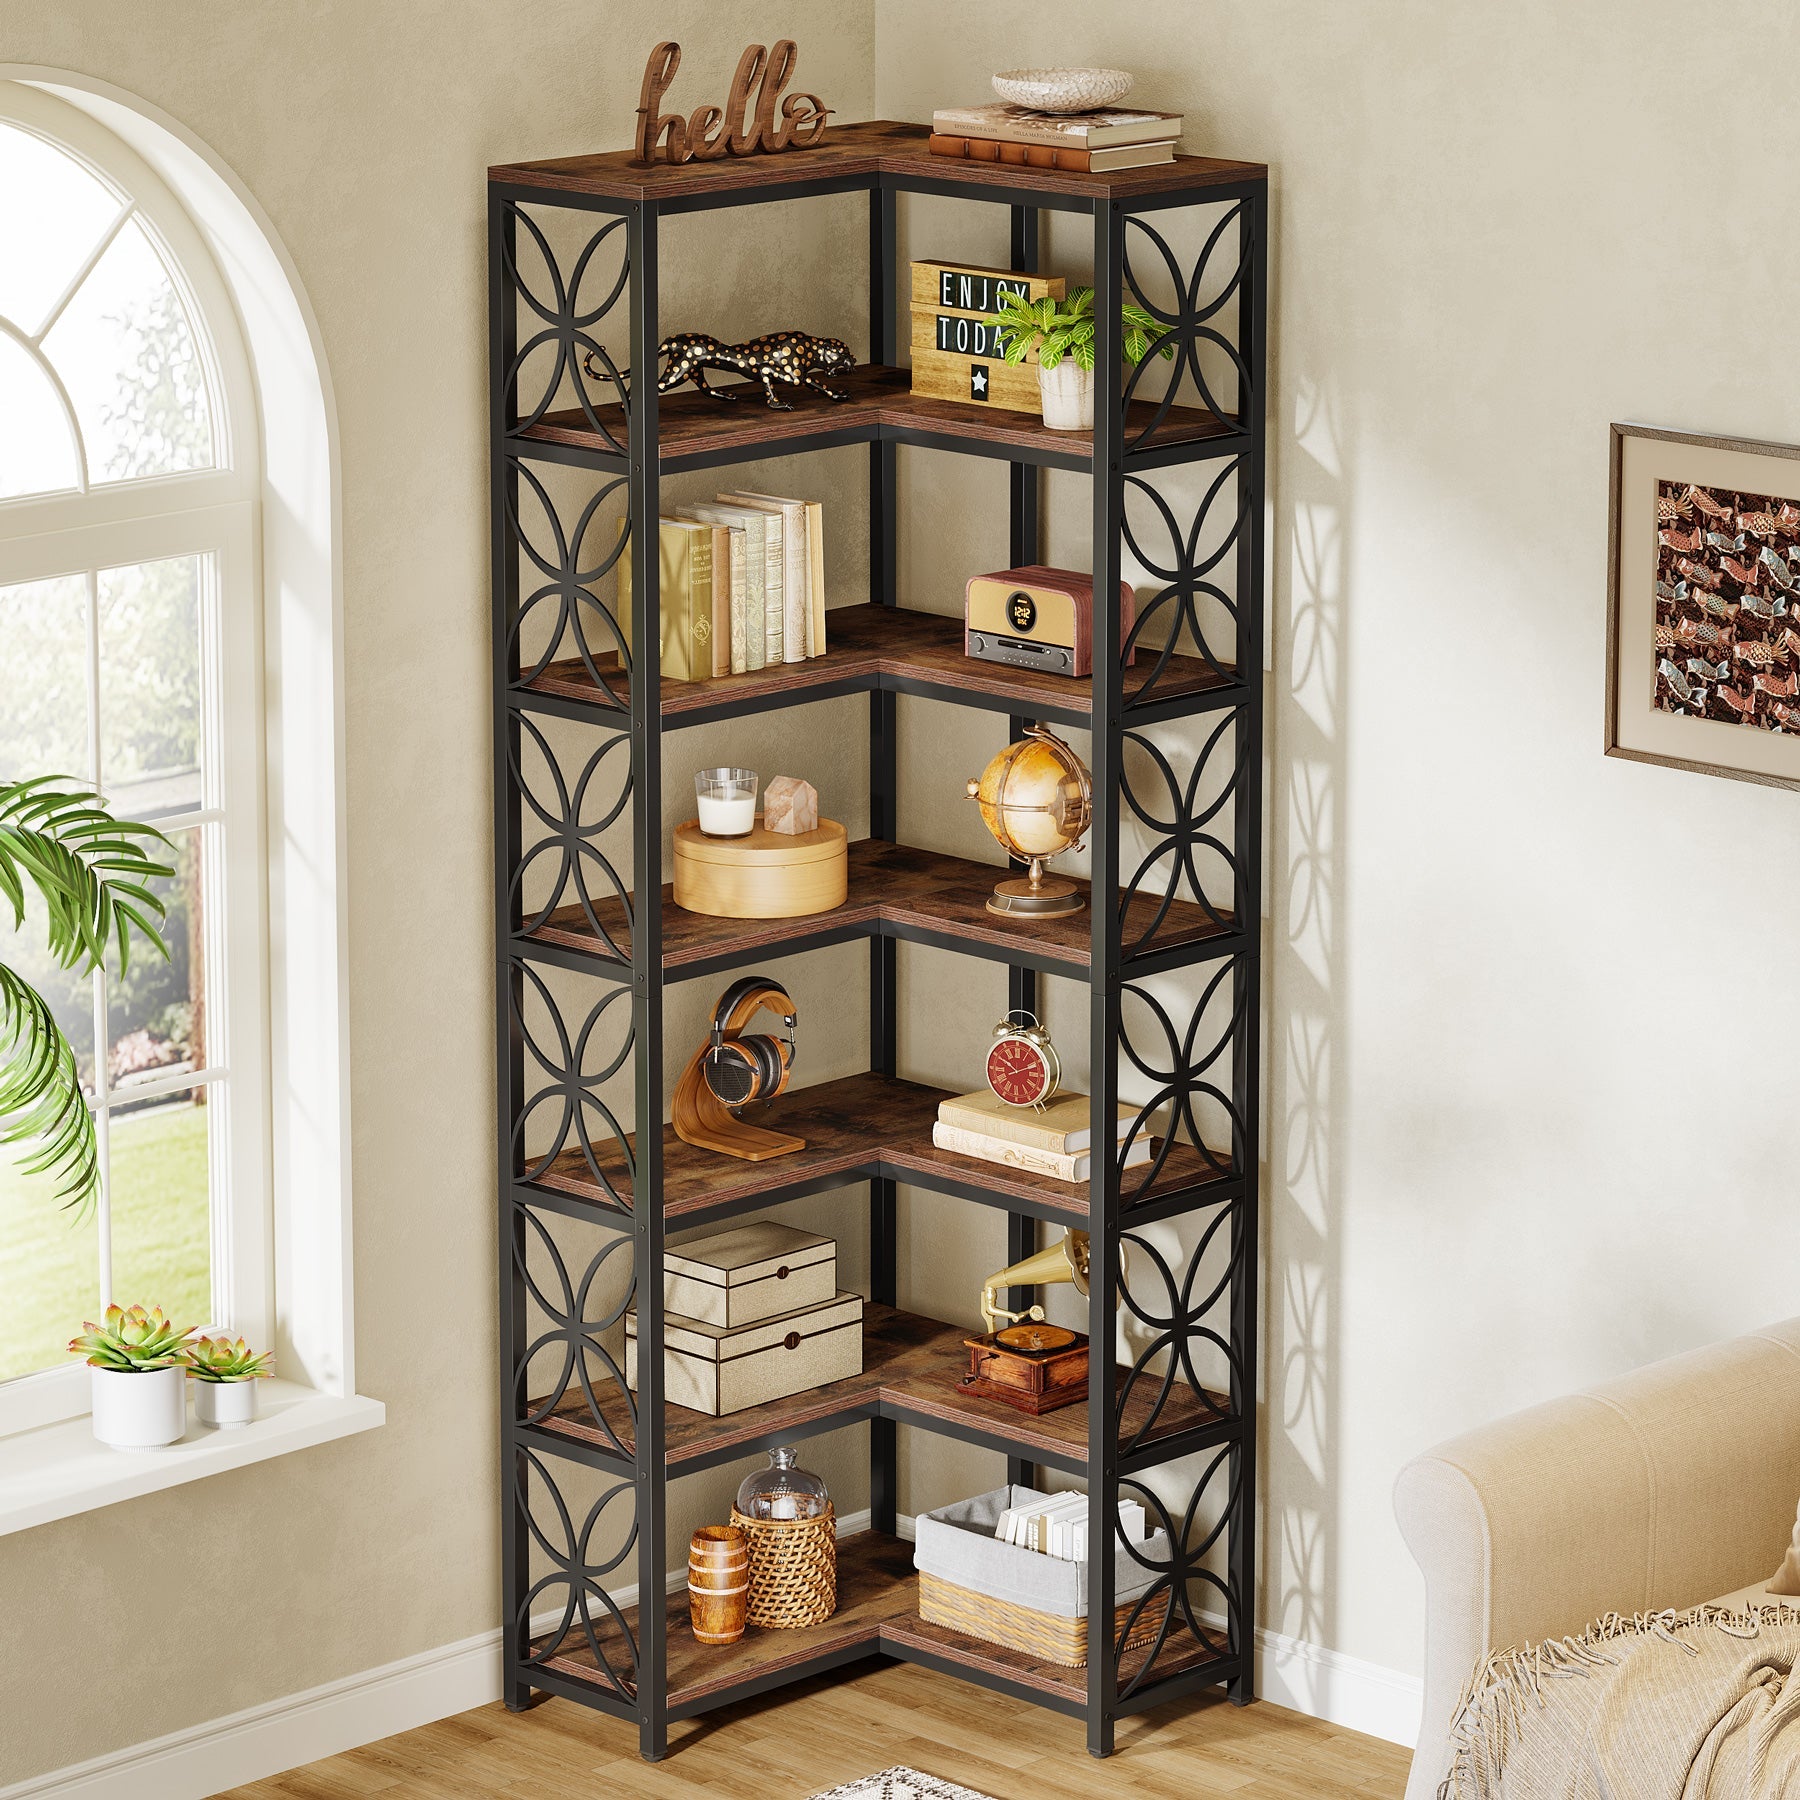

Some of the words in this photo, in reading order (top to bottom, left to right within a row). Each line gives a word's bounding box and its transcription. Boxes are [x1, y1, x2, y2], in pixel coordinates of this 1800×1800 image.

[635, 39, 836, 165] hello
[943, 273, 1026, 313] ENJOY
[939, 317, 1017, 358] TODA
